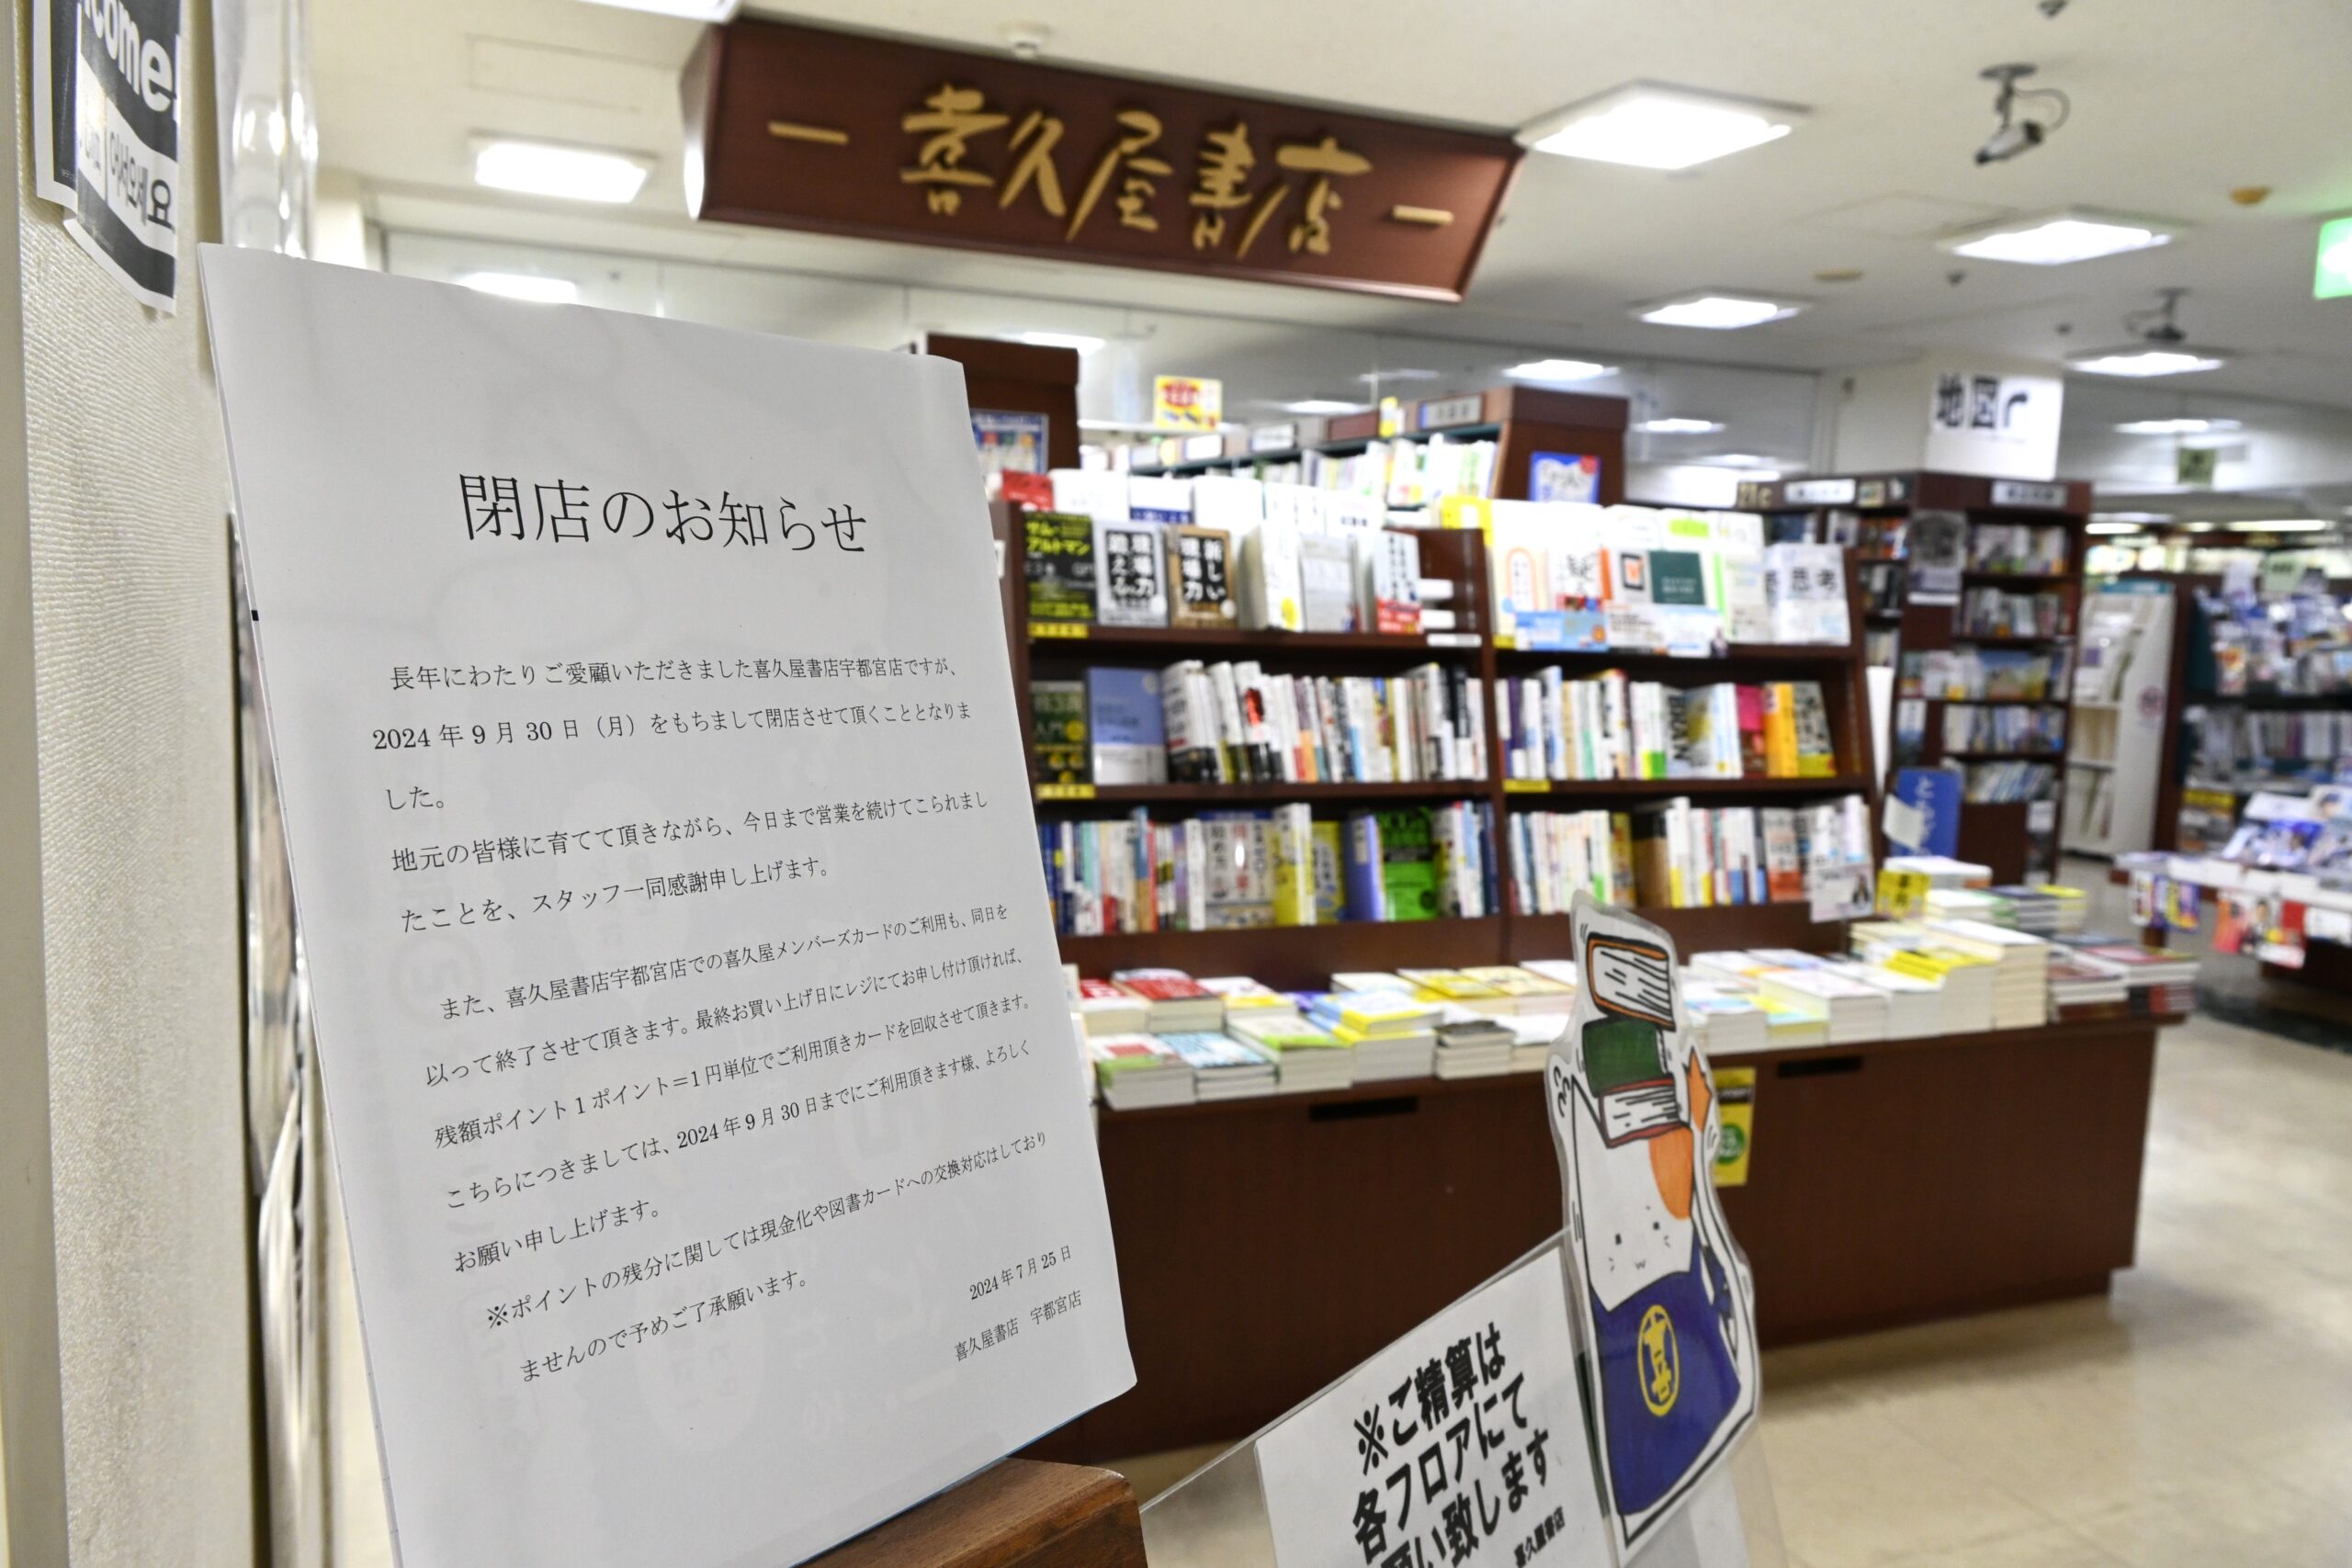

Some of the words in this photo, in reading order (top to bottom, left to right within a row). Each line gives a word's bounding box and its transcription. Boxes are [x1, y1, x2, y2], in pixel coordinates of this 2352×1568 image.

[901, 85, 1372, 258] 喜久屋書店
[460, 474, 866, 552] 閉店のお知らせ
[390, 658, 956, 691] 長年にわたりご愛顧いただきました喜久屋書店宇都宮店ですが、
[386, 785, 445, 810] した。
[390, 792, 989, 873] 地元の皆様に育てて頂きながら、今日まで営業を続けてこられまし
[401, 857, 828, 933] たことを、スタッフ一同感謝申し上げます。
[439, 904, 1007, 1021] また、喜久屋書店宇都宮店での喜久屋メンバーズカードのご利用も、同日を
[425, 948, 1022, 1088] 以って終了させて頂きます。最終お買い上げ日にレジにてお申し付け頂ければ、
[454, 1199, 659, 1273] お願い申し上げます。
[487, 1132, 1046, 1328] ※ポイントの残分に関しては現金化や図書カードへの交換対応はしており
[520, 1270, 806, 1382] ませんので予めご了承願います。
[955, 1317, 1019, 1362] 喜久屋書店
[1030, 1290, 1081, 1325] 宇都宮店
[1353, 1322, 1506, 1476] ※ご精算は
[1351, 1371, 1528, 1565] 各フロアにて
